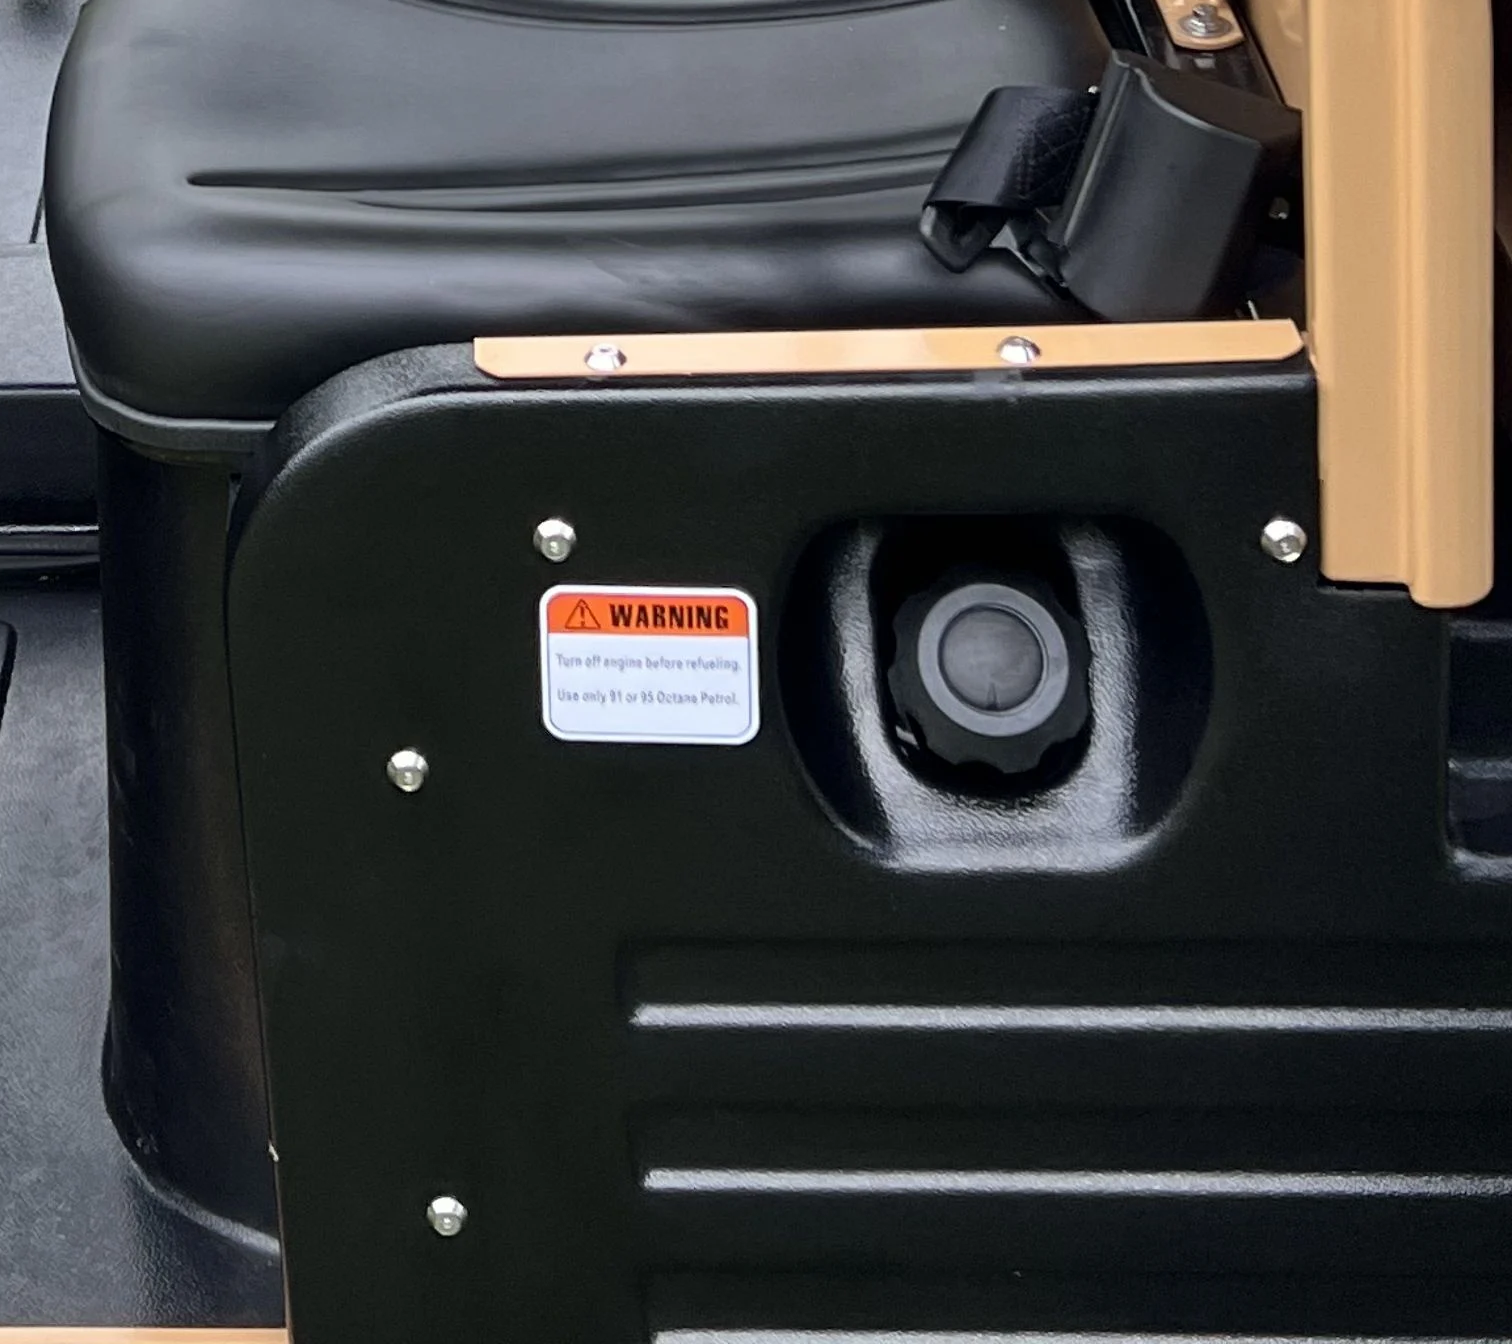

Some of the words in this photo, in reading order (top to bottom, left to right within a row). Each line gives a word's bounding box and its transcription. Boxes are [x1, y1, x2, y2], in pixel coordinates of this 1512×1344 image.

[609, 603, 729, 630] WARNING
[555, 653, 582, 668] Turn
[585, 654, 601, 669] off
[603, 656, 643, 673] engine
[645, 656, 683, 670] before
[557, 688, 579, 702] Use
[582, 690, 606, 705] only
[609, 689, 623, 703] 91
[625, 692, 638, 703] or
[640, 690, 654, 704] 95
[656, 691, 698, 704] Octane
